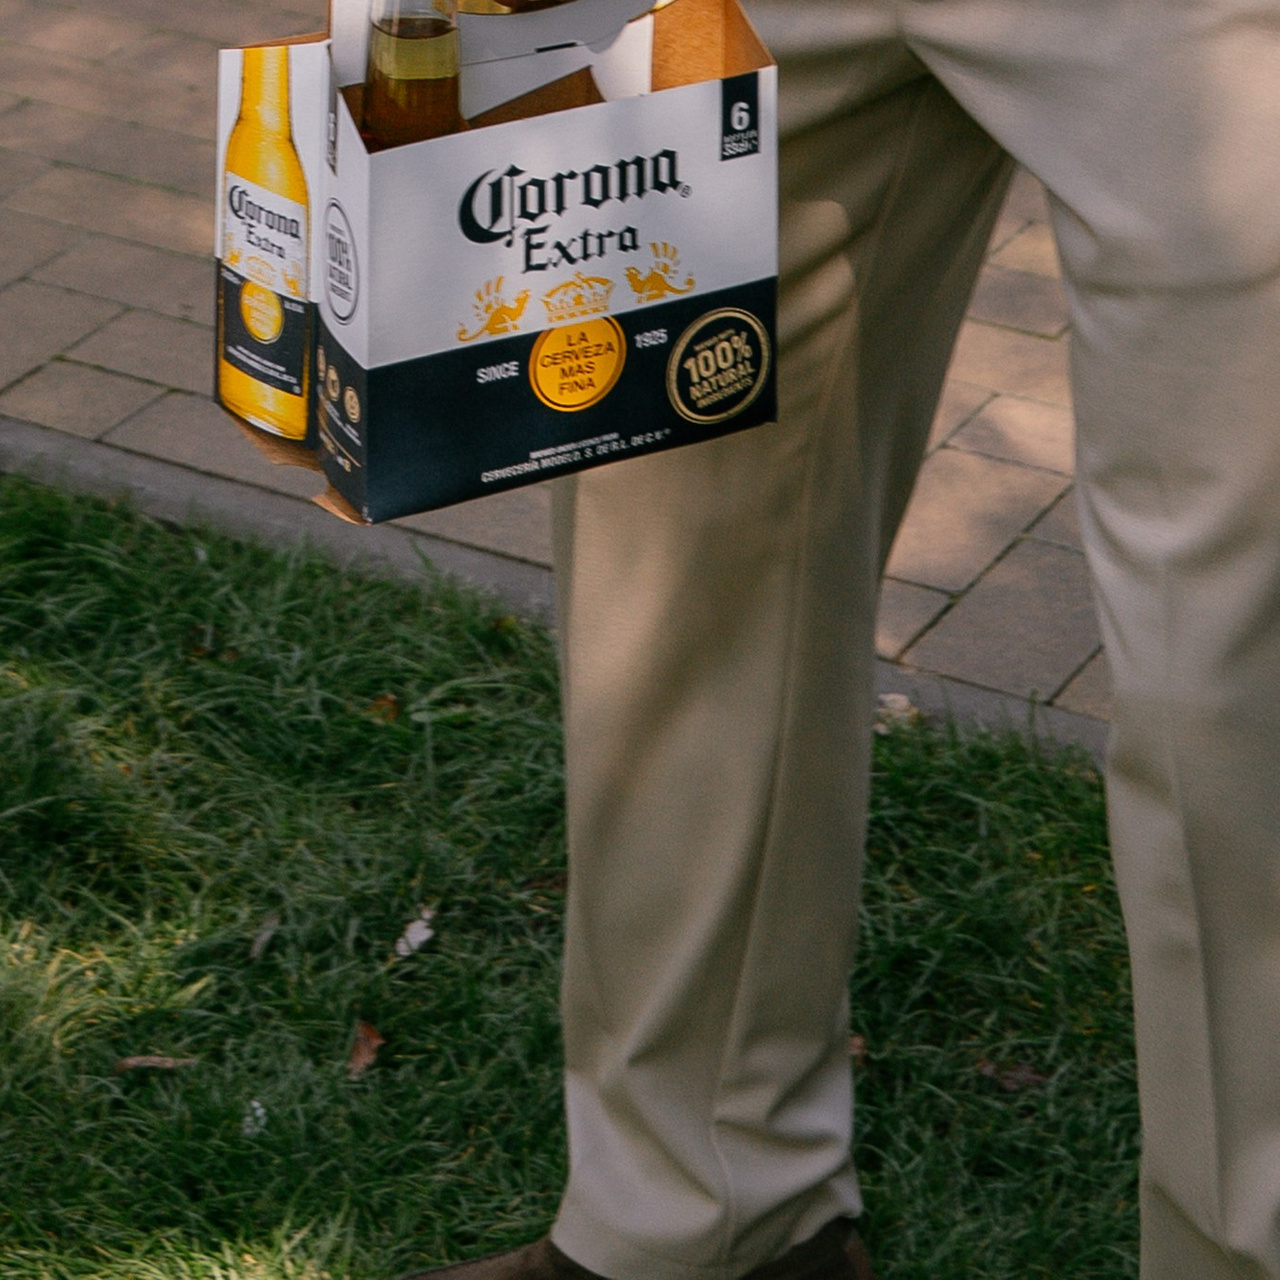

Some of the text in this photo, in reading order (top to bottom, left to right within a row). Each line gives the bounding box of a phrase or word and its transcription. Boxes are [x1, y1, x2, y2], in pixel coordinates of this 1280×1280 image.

[730, 101, 750, 131] 6
[229, 185, 302, 239] Corona
[459, 149, 680, 248] Corona
[242, 222, 286, 259] Extra
[520, 225, 640, 274] Extra
[566, 331, 589, 347] LA
[634, 328, 669, 348] 1925
[540, 341, 616, 368] CERVEZA
[683, 331, 753, 383] 100%
[476, 361, 519, 384] SINCE
[560, 361, 596, 379] MAS
[688, 360, 756, 400] NATURAL
[559, 377, 596, 395] FINA
